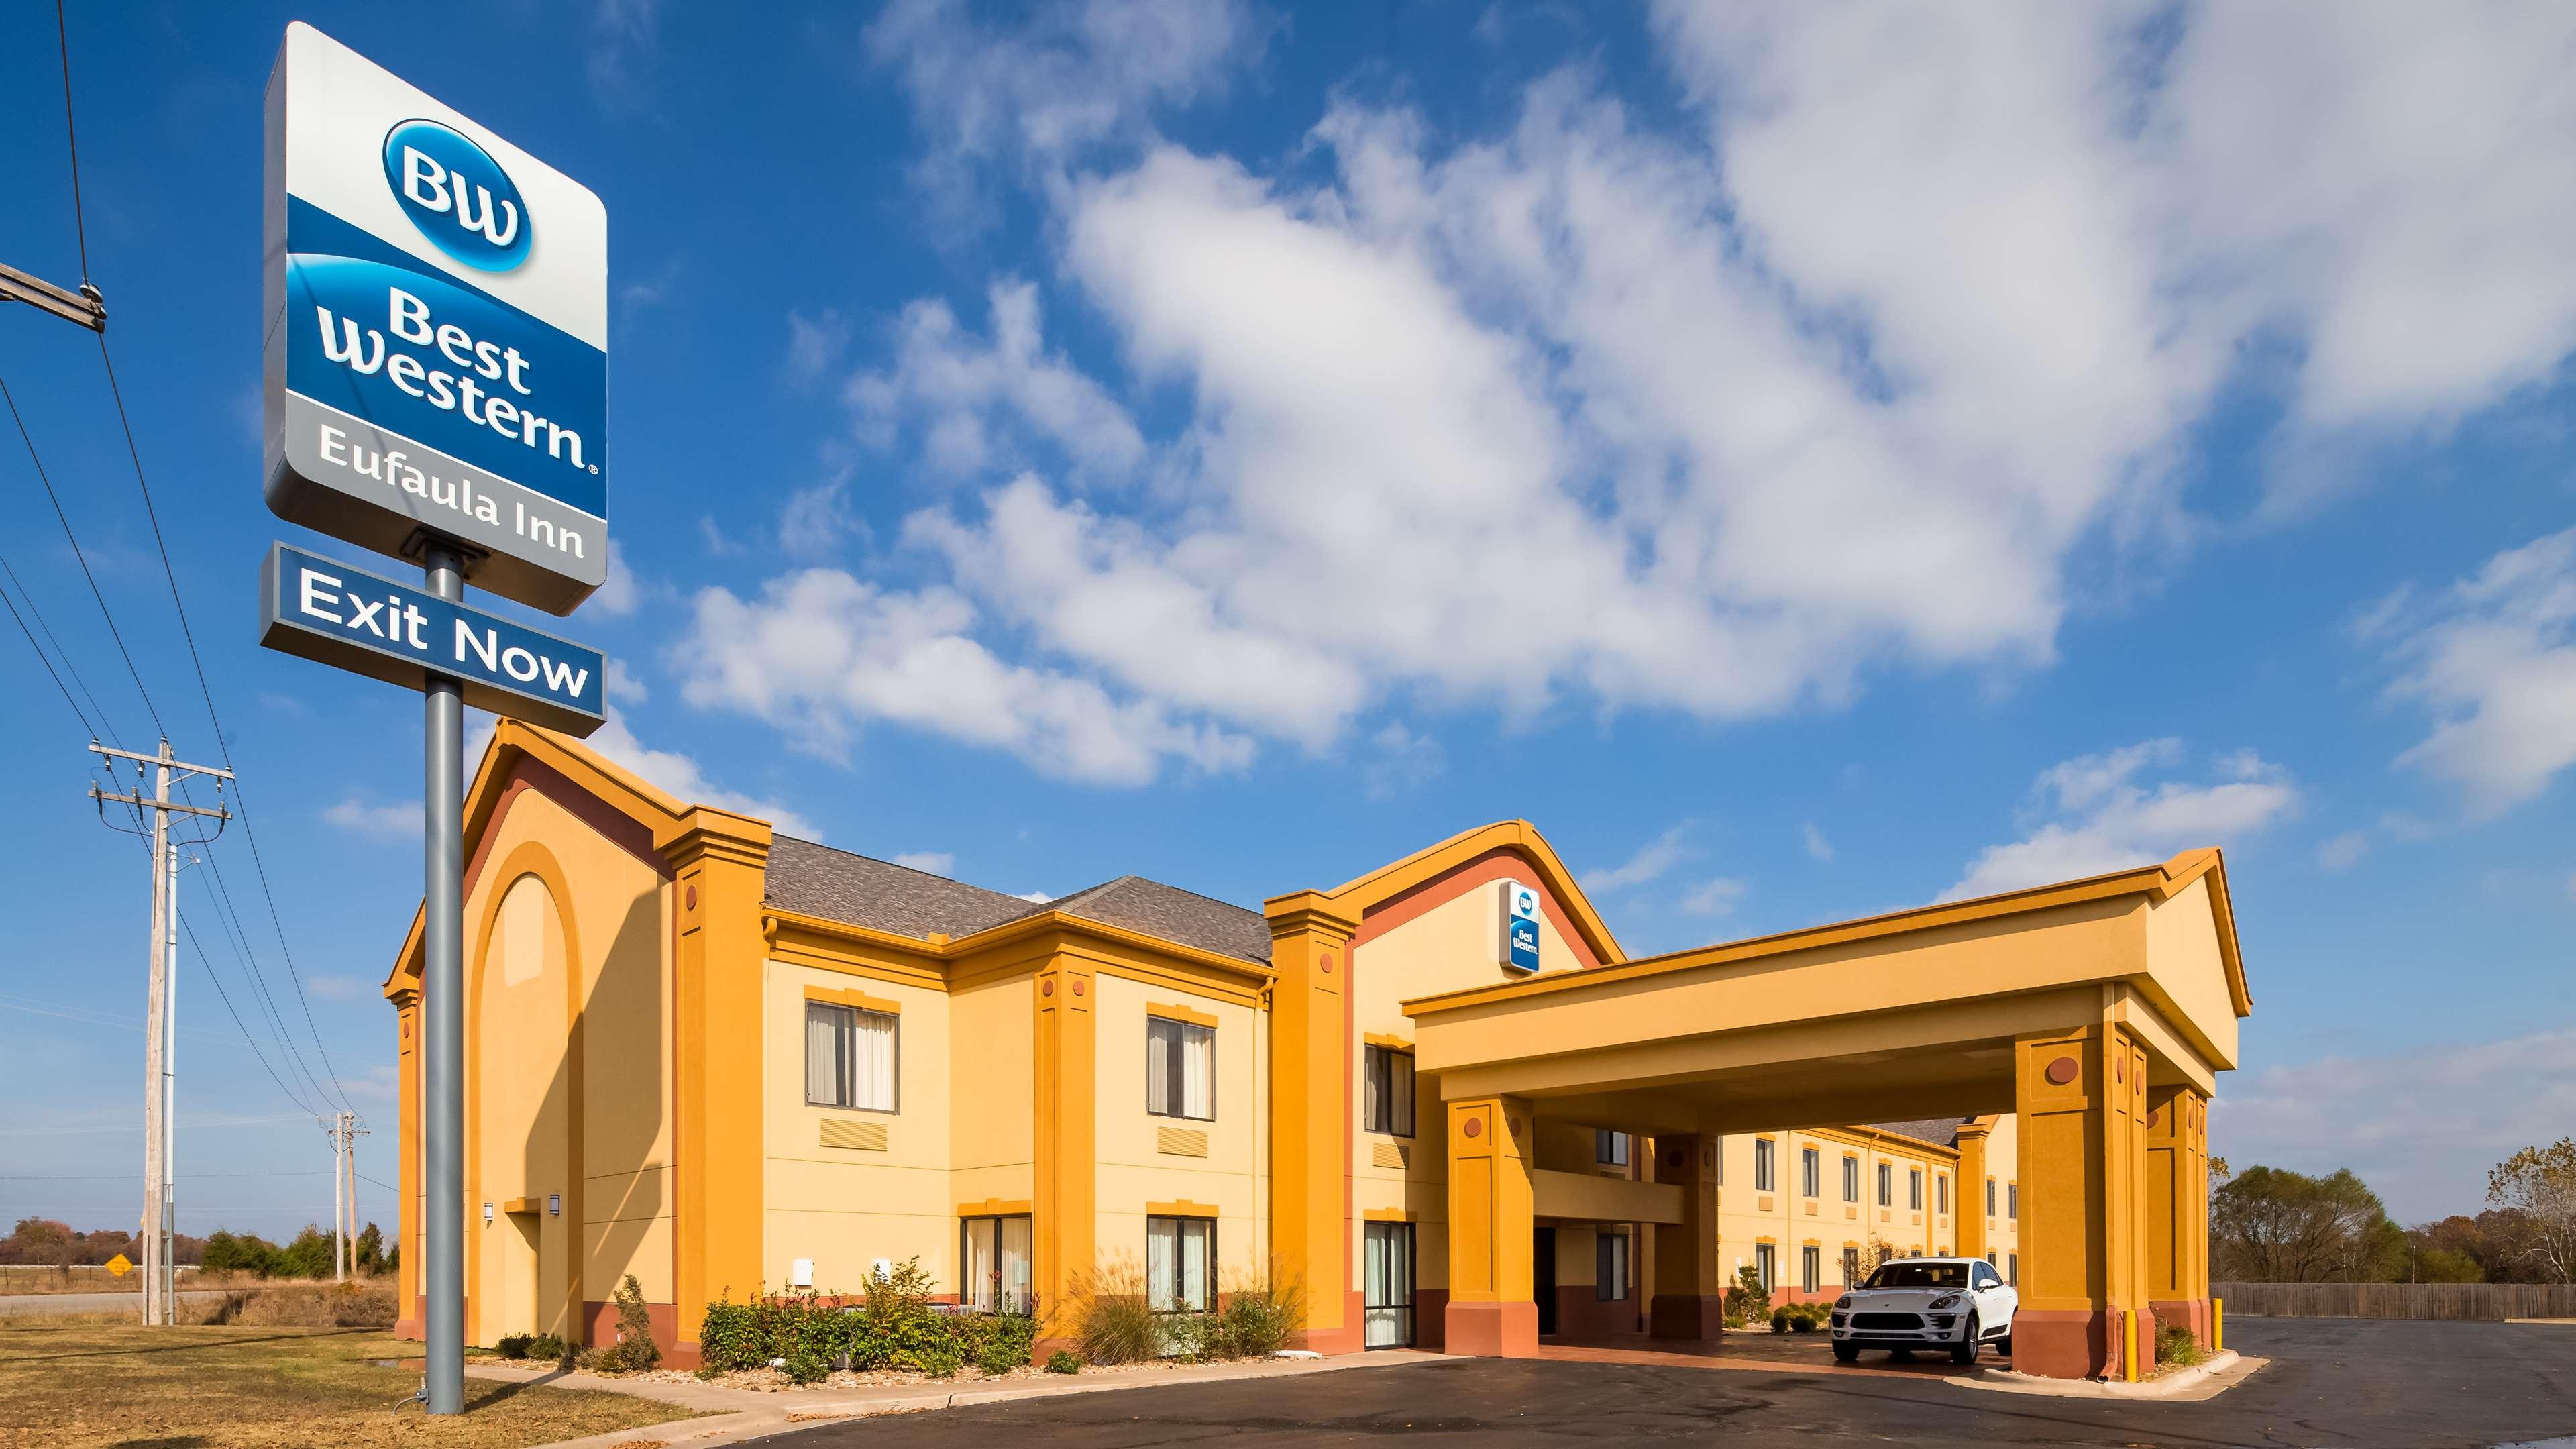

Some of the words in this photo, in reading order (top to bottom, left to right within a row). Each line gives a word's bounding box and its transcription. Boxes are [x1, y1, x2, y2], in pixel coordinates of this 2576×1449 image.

[404, 145, 519, 246] BW
[317, 305, 586, 469] Western
[390, 286, 532, 395] Best
[320, 423, 500, 526] Eufaula
[515, 502, 584, 559] Inn
[301, 568, 428, 650] Exit
[455, 618, 589, 698] Now
[1519, 929, 1533, 943] Best
[1520, 896, 1532, 910] BW
